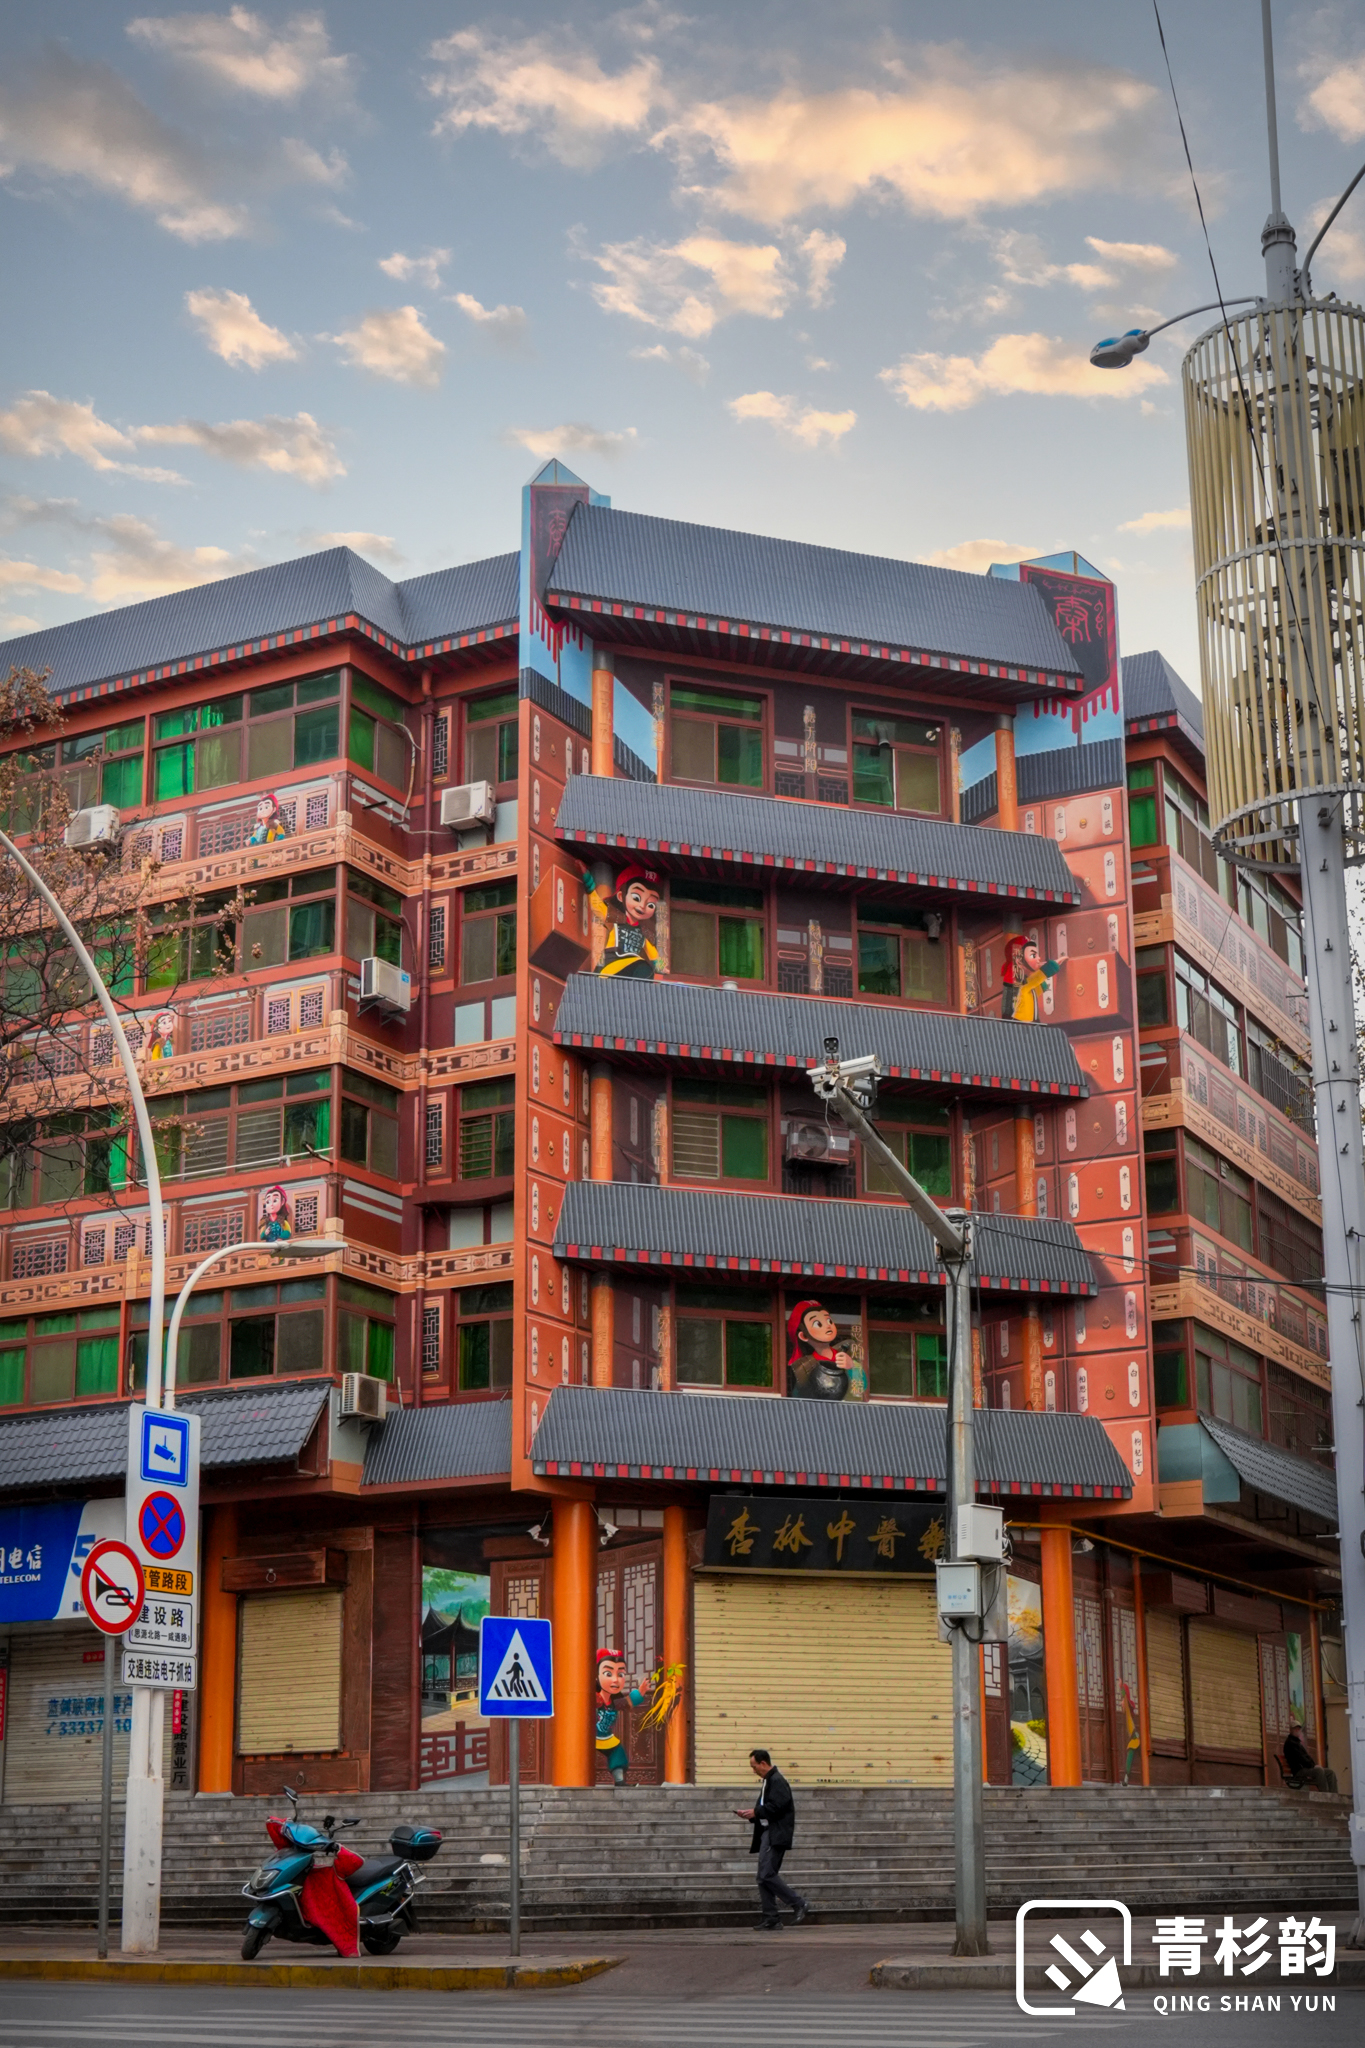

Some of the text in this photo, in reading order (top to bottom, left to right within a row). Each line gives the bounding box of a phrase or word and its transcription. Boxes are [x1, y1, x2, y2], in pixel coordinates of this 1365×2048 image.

[137, 1604, 184, 1627] 建设路
[128, 1658, 192, 1682] 交通违法电子抓拍
